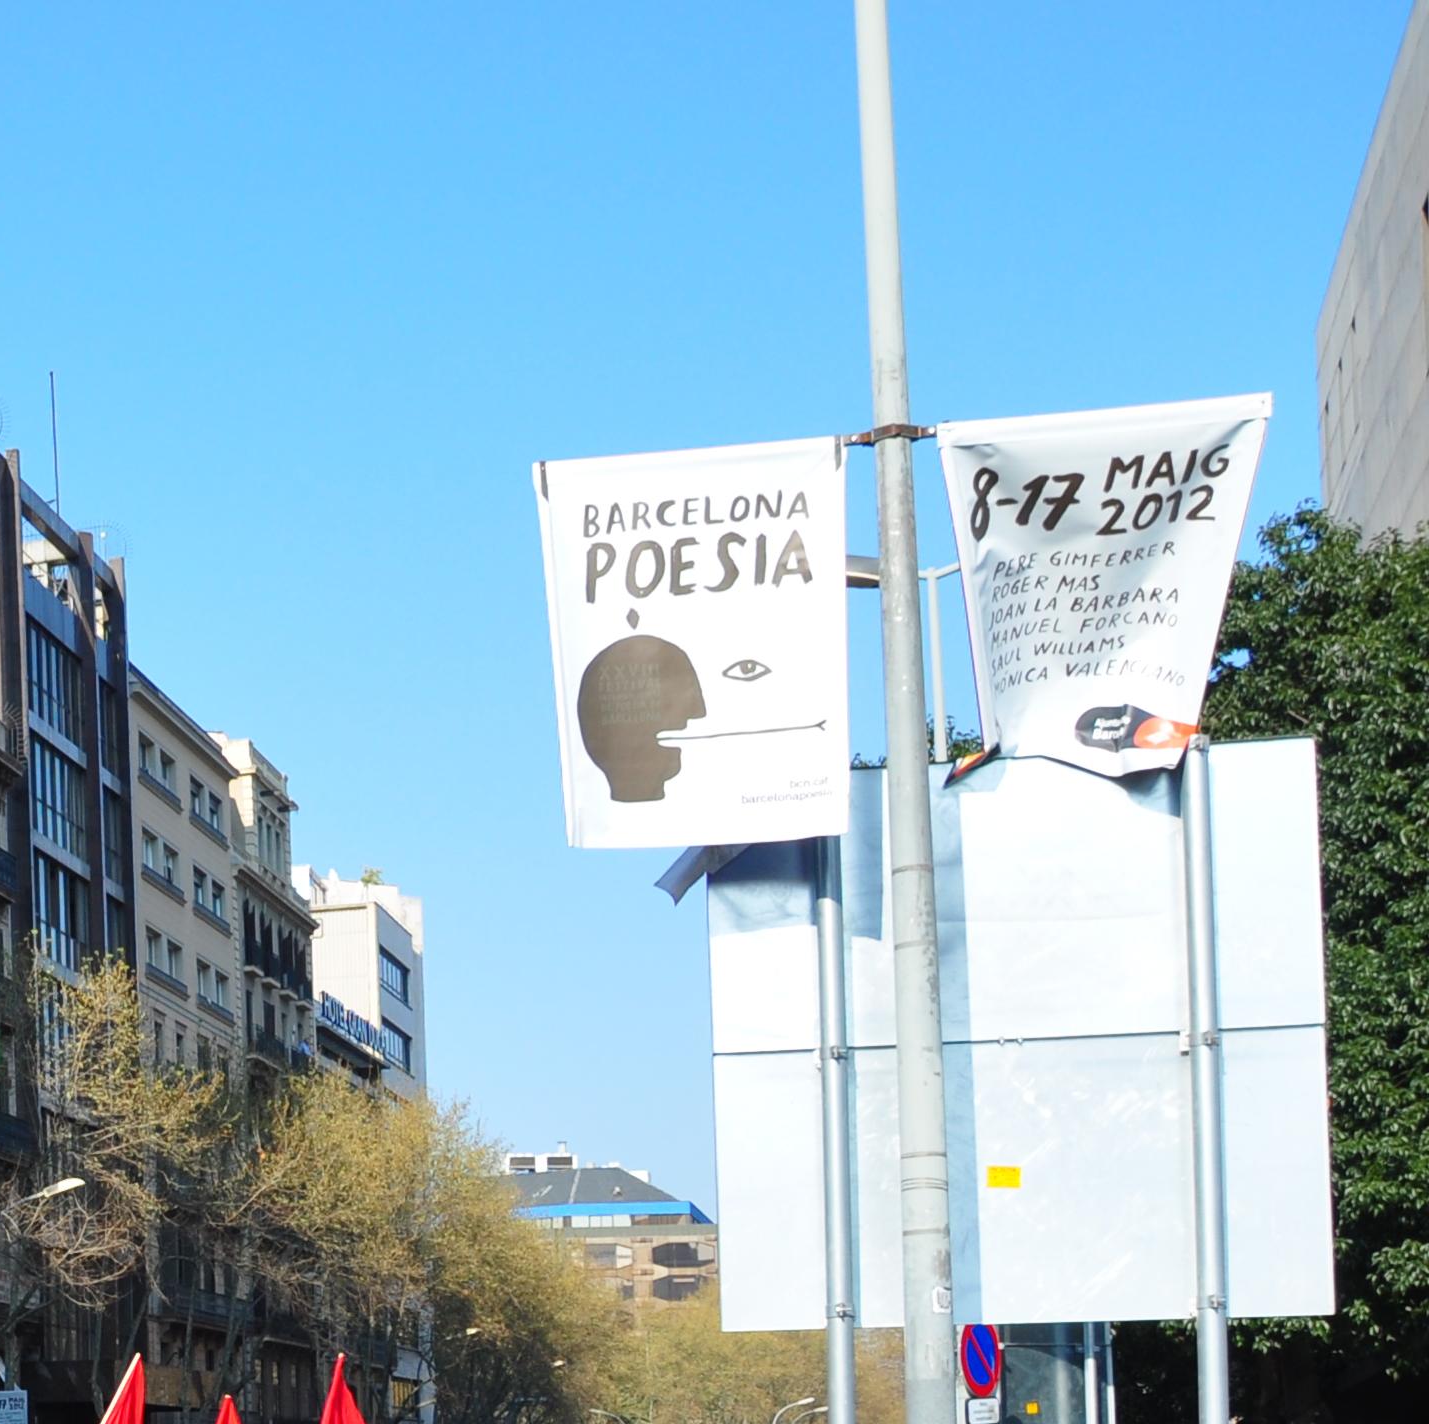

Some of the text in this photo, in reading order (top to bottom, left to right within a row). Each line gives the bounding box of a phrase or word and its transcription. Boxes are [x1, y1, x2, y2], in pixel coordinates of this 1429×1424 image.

[1103, 443, 1230, 493] MAIG
[583, 489, 810, 538] BARCELONA
[970, 467, 1085, 542] 8-17
[1095, 484, 1216, 535] 2012
[585, 530, 814, 604] POESIA
[992, 541, 1176, 581] PERE GIMFERRER
[988, 587, 1179, 631] JOAN LA BARBARA
[992, 574, 1101, 603] ROGER MAS
[990, 611, 1178, 648] MANUEL FORCANO
[991, 635, 1126, 677] SAUL WILLIAMS
[1064, 659, 1186, 687] VALENCIANO
